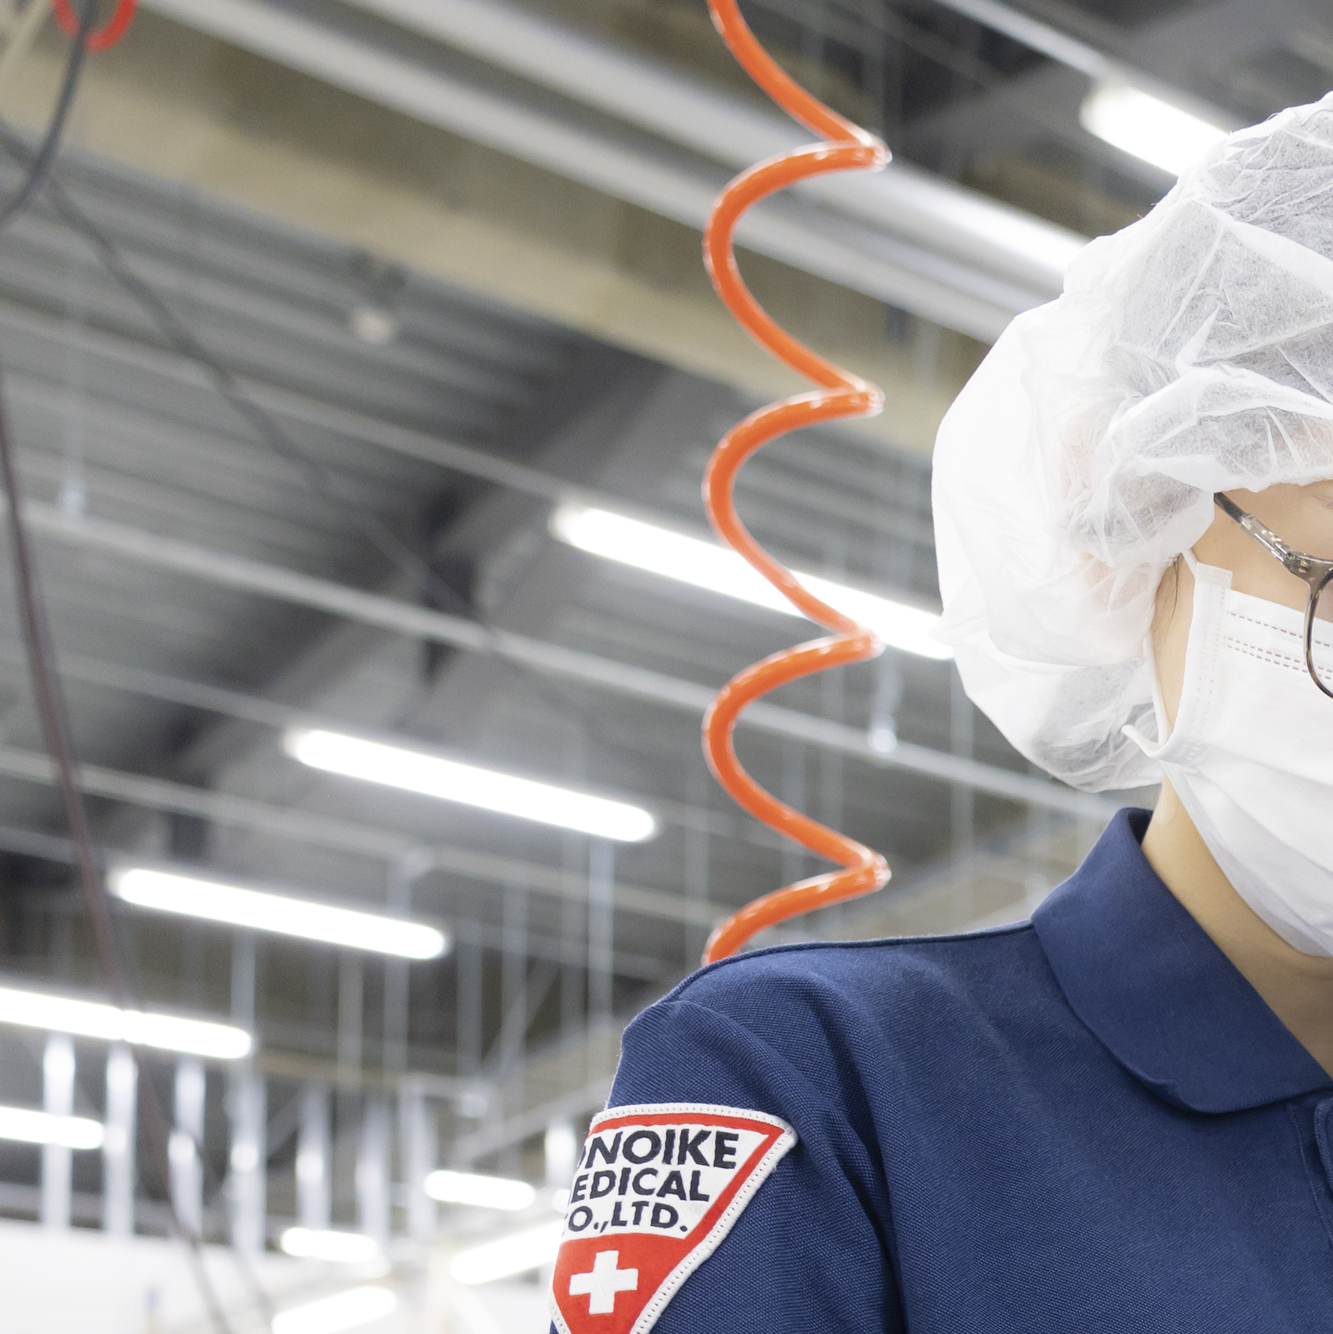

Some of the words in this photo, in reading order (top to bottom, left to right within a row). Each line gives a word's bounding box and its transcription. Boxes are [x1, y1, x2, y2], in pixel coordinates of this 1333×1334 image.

[580, 1128, 739, 1169] NOIKE
[569, 1167, 710, 1204] EDICAL
[565, 1200, 688, 1234] O.,LTD.
